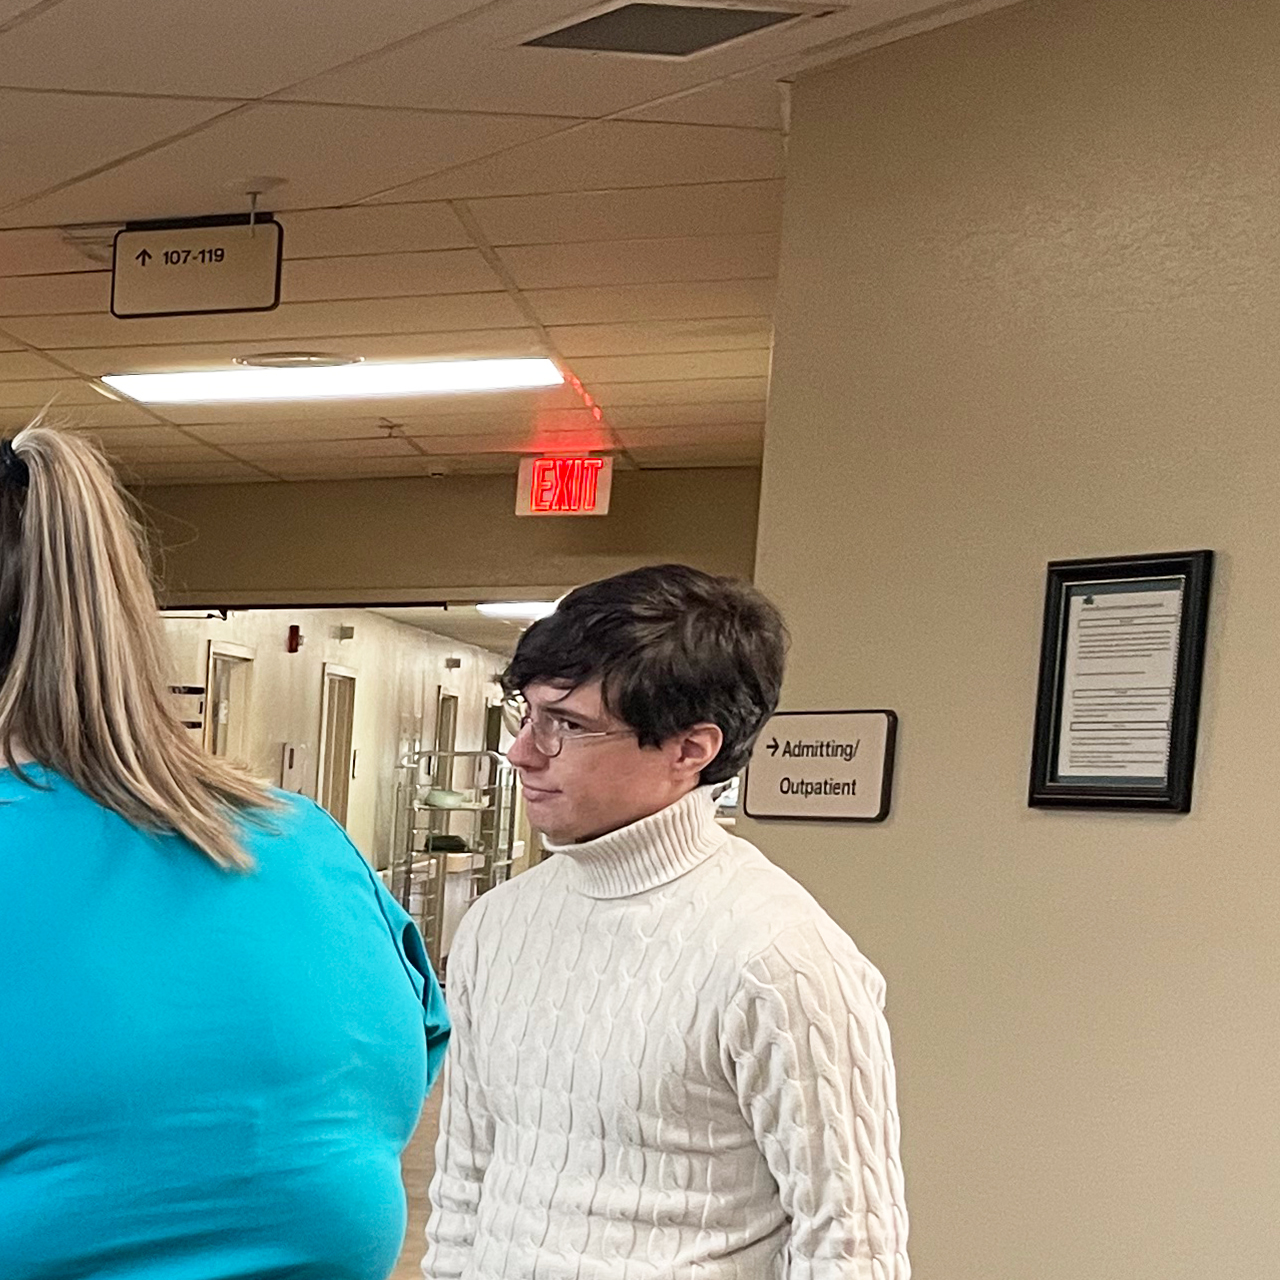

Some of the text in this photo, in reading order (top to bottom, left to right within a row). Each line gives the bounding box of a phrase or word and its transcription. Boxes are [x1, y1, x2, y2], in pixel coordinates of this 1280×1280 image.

[163, 248, 224, 265] 107-119
[531, 458, 603, 511] EXIT
[782, 739, 860, 761] Admitting/
[780, 777, 856, 798] Outpatient
